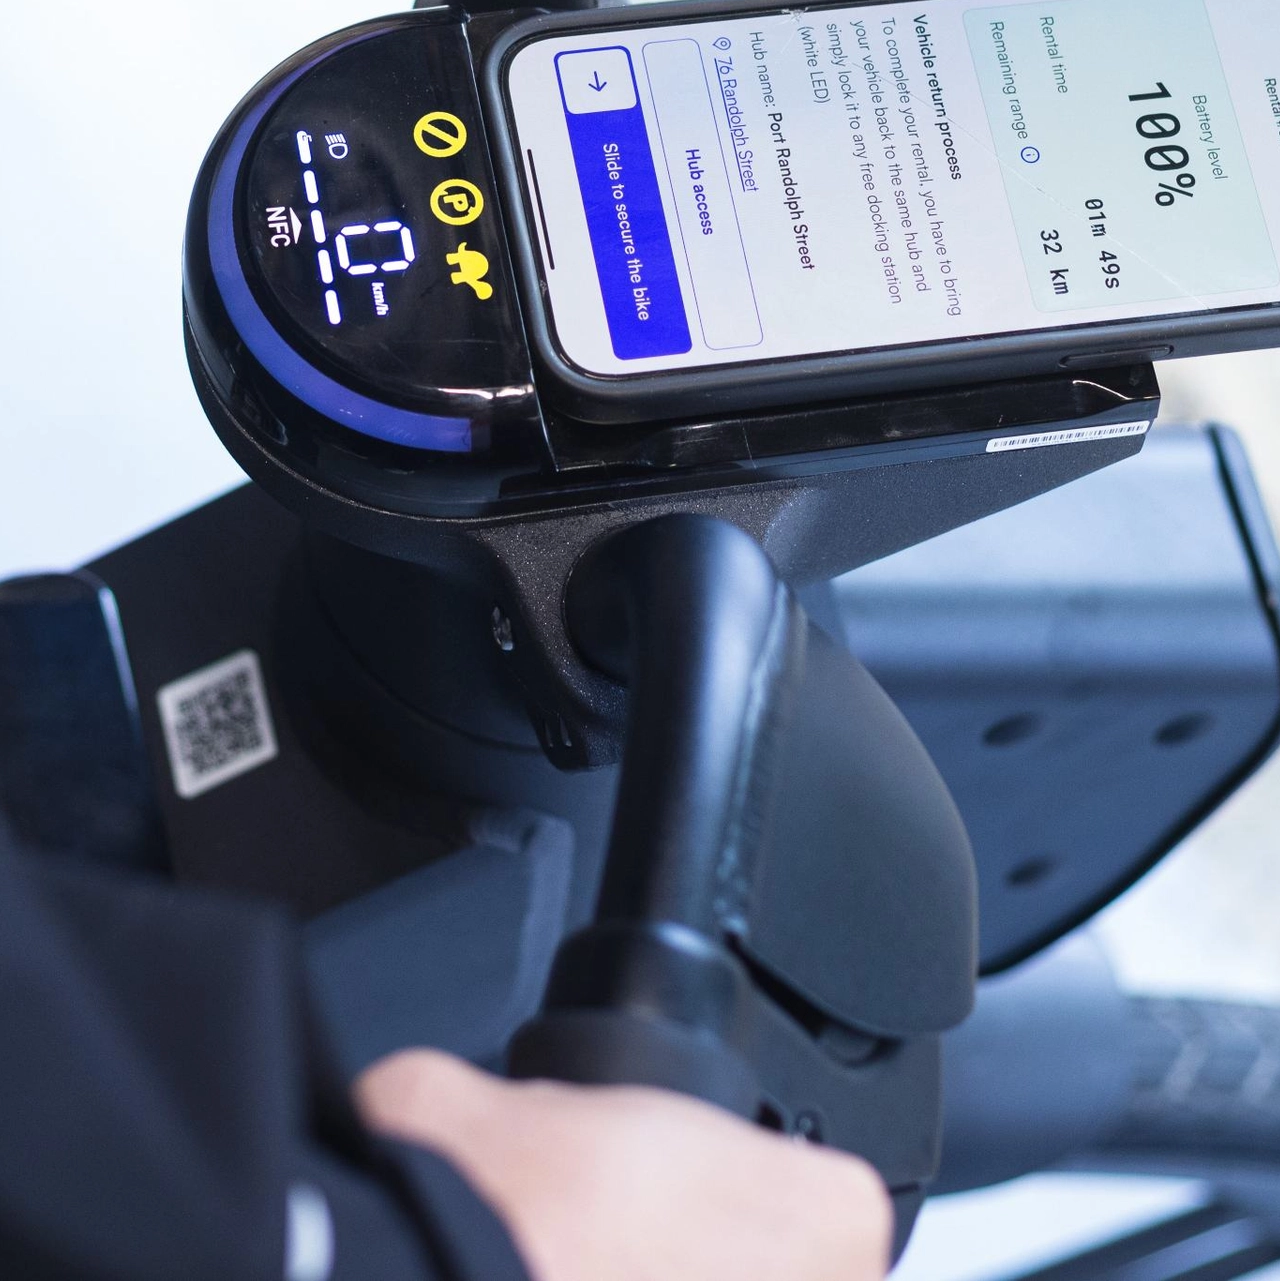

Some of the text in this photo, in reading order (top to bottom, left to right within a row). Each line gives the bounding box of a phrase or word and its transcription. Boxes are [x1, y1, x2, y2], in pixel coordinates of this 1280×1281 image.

[797, 26, 831, 104] (white LED)
[882, 17, 896, 36] To
[1039, 16, 1068, 94] Rental time
[885, 40, 910, 104] complete
[913, 14, 962, 180] Vehicle return process
[989, 21, 1028, 139] Remaining range
[717, 57, 759, 192] 76 Randolph Street
[749, 31, 815, 270] Hub name: Port Randolph Street
[849, 20, 931, 292] your vehicle back to the same hub and
[898, 106, 919, 138] your
[1128, 81, 1196, 206] 100%
[1192, 95, 1228, 180] Battery level
[685, 148, 713, 235] Hub access
[826, 23, 902, 304] simply lock it to any free docking station
[265, 206, 291, 248] NFC
[603, 142, 649, 321] Slide to secure the bike
[918, 190, 937, 217] you
[930, 221, 946, 256] have
[940, 259, 951, 274] to
[1040, 229, 1069, 295] 32 km
[1085, 198, 1120, 289] 01m 49s
[372, 282, 389, 316] km/h
[943, 278, 962, 317] bring
